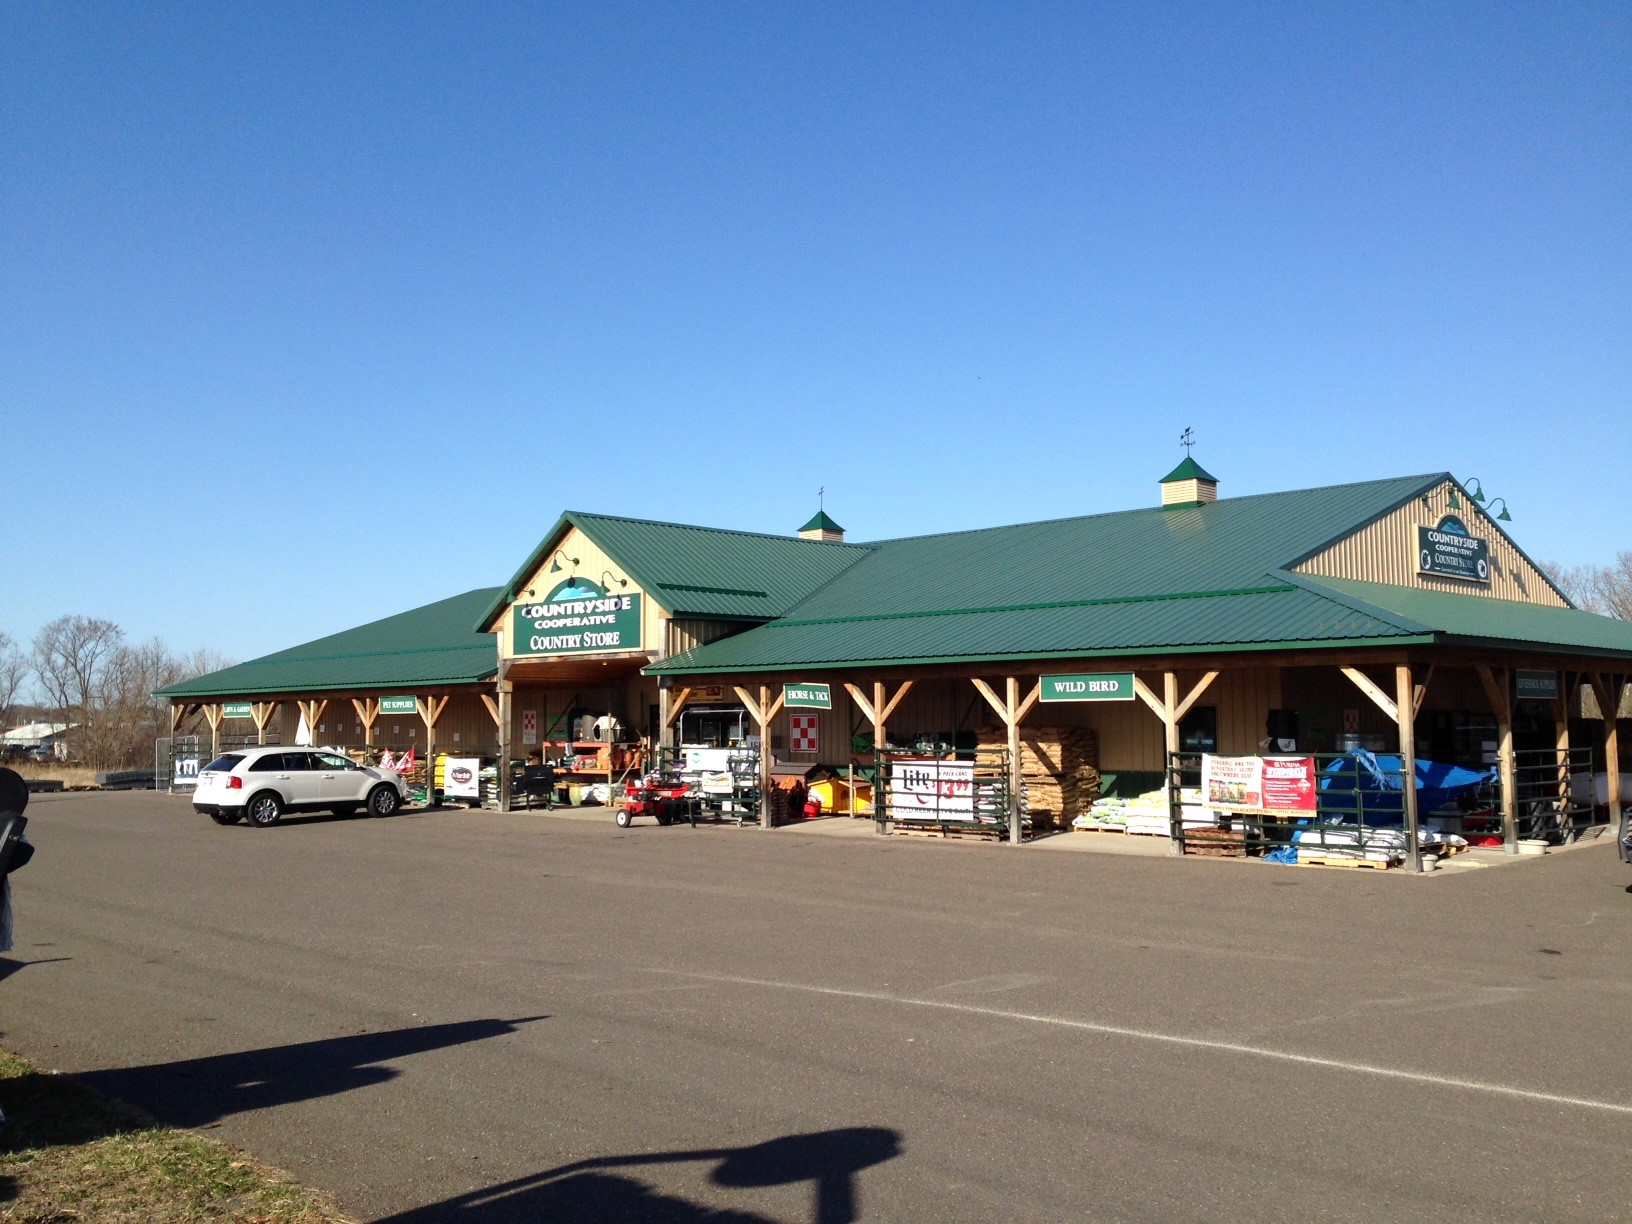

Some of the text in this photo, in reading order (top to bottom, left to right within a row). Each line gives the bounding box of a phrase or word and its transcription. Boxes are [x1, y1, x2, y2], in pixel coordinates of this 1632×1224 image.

[1428, 531, 1479, 550] COUNTRYSIDE
[1435, 544, 1473, 557] COOPERATIVE
[1434, 553, 1459, 567] COUNTRY
[521, 597, 632, 618] COUNTRYSIDE
[534, 614, 616, 629] COOPERATIVE
[530, 631, 620, 651] COUNTRY STORE
[1054, 680, 1119, 693] WILD BIRD
[787, 690, 829, 701] HORSE & TACK
[382, 700, 414, 709] PET SUPPLIES
